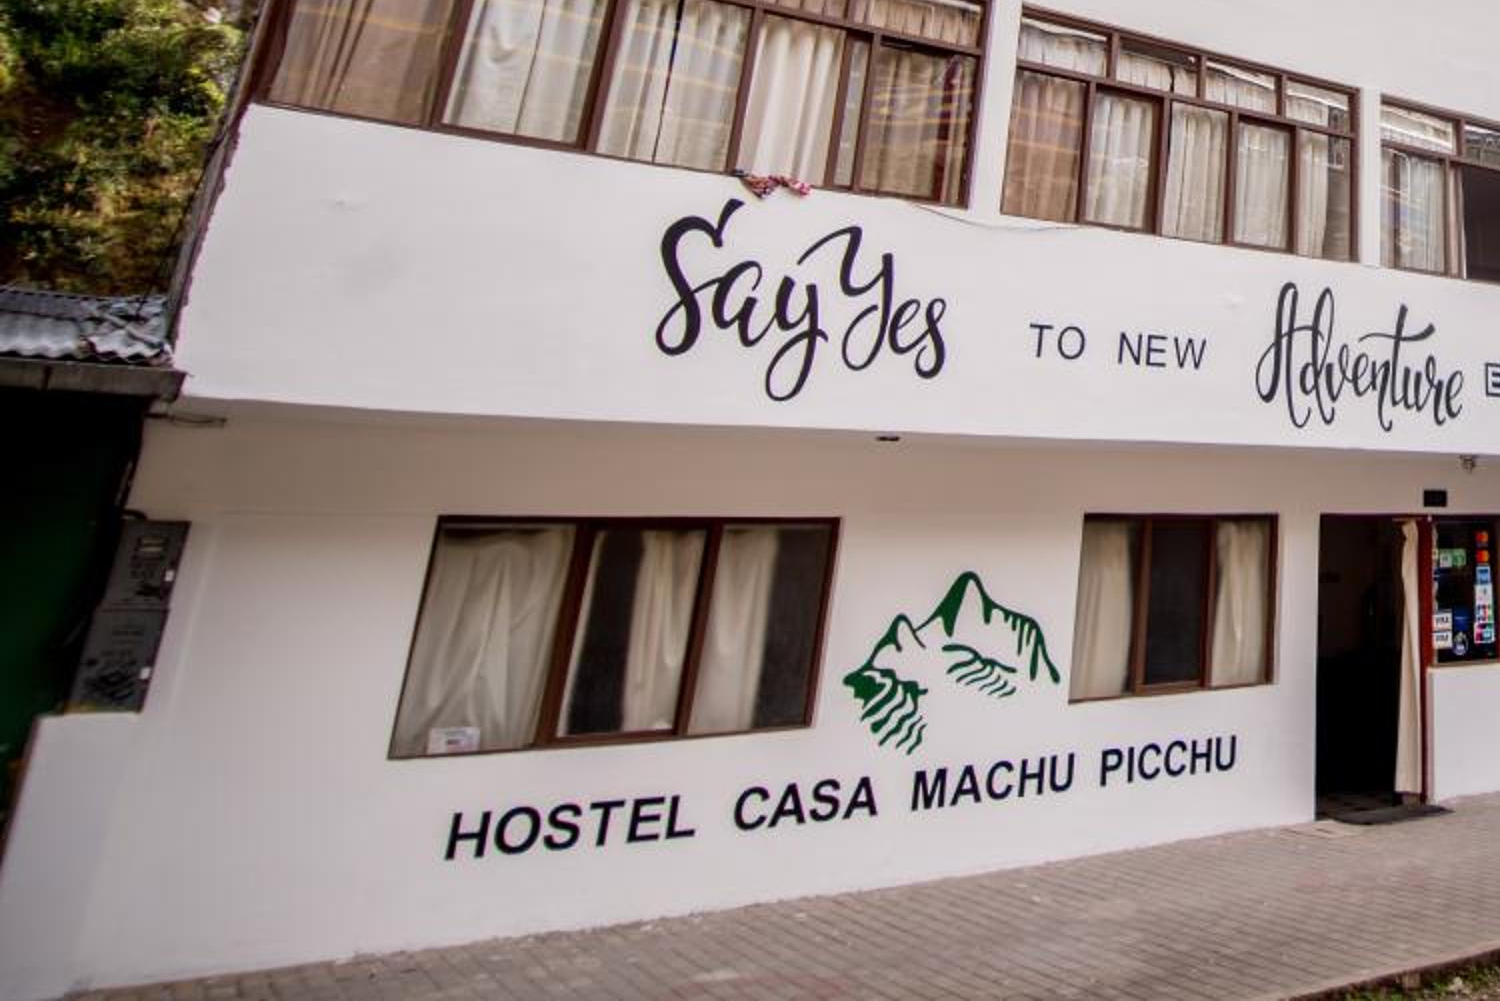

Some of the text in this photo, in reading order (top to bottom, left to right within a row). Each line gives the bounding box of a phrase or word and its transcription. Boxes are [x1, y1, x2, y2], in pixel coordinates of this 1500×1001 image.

[655, 198, 829, 402] Say
[796, 225, 947, 380] Yes
[1028, 323, 1086, 360] TO
[1117, 332, 1207, 370] NEW
[1255, 281, 1464, 432] Adventure
[444, 734, 1238, 862] HOSTEL CASA MACHU PICCHU
